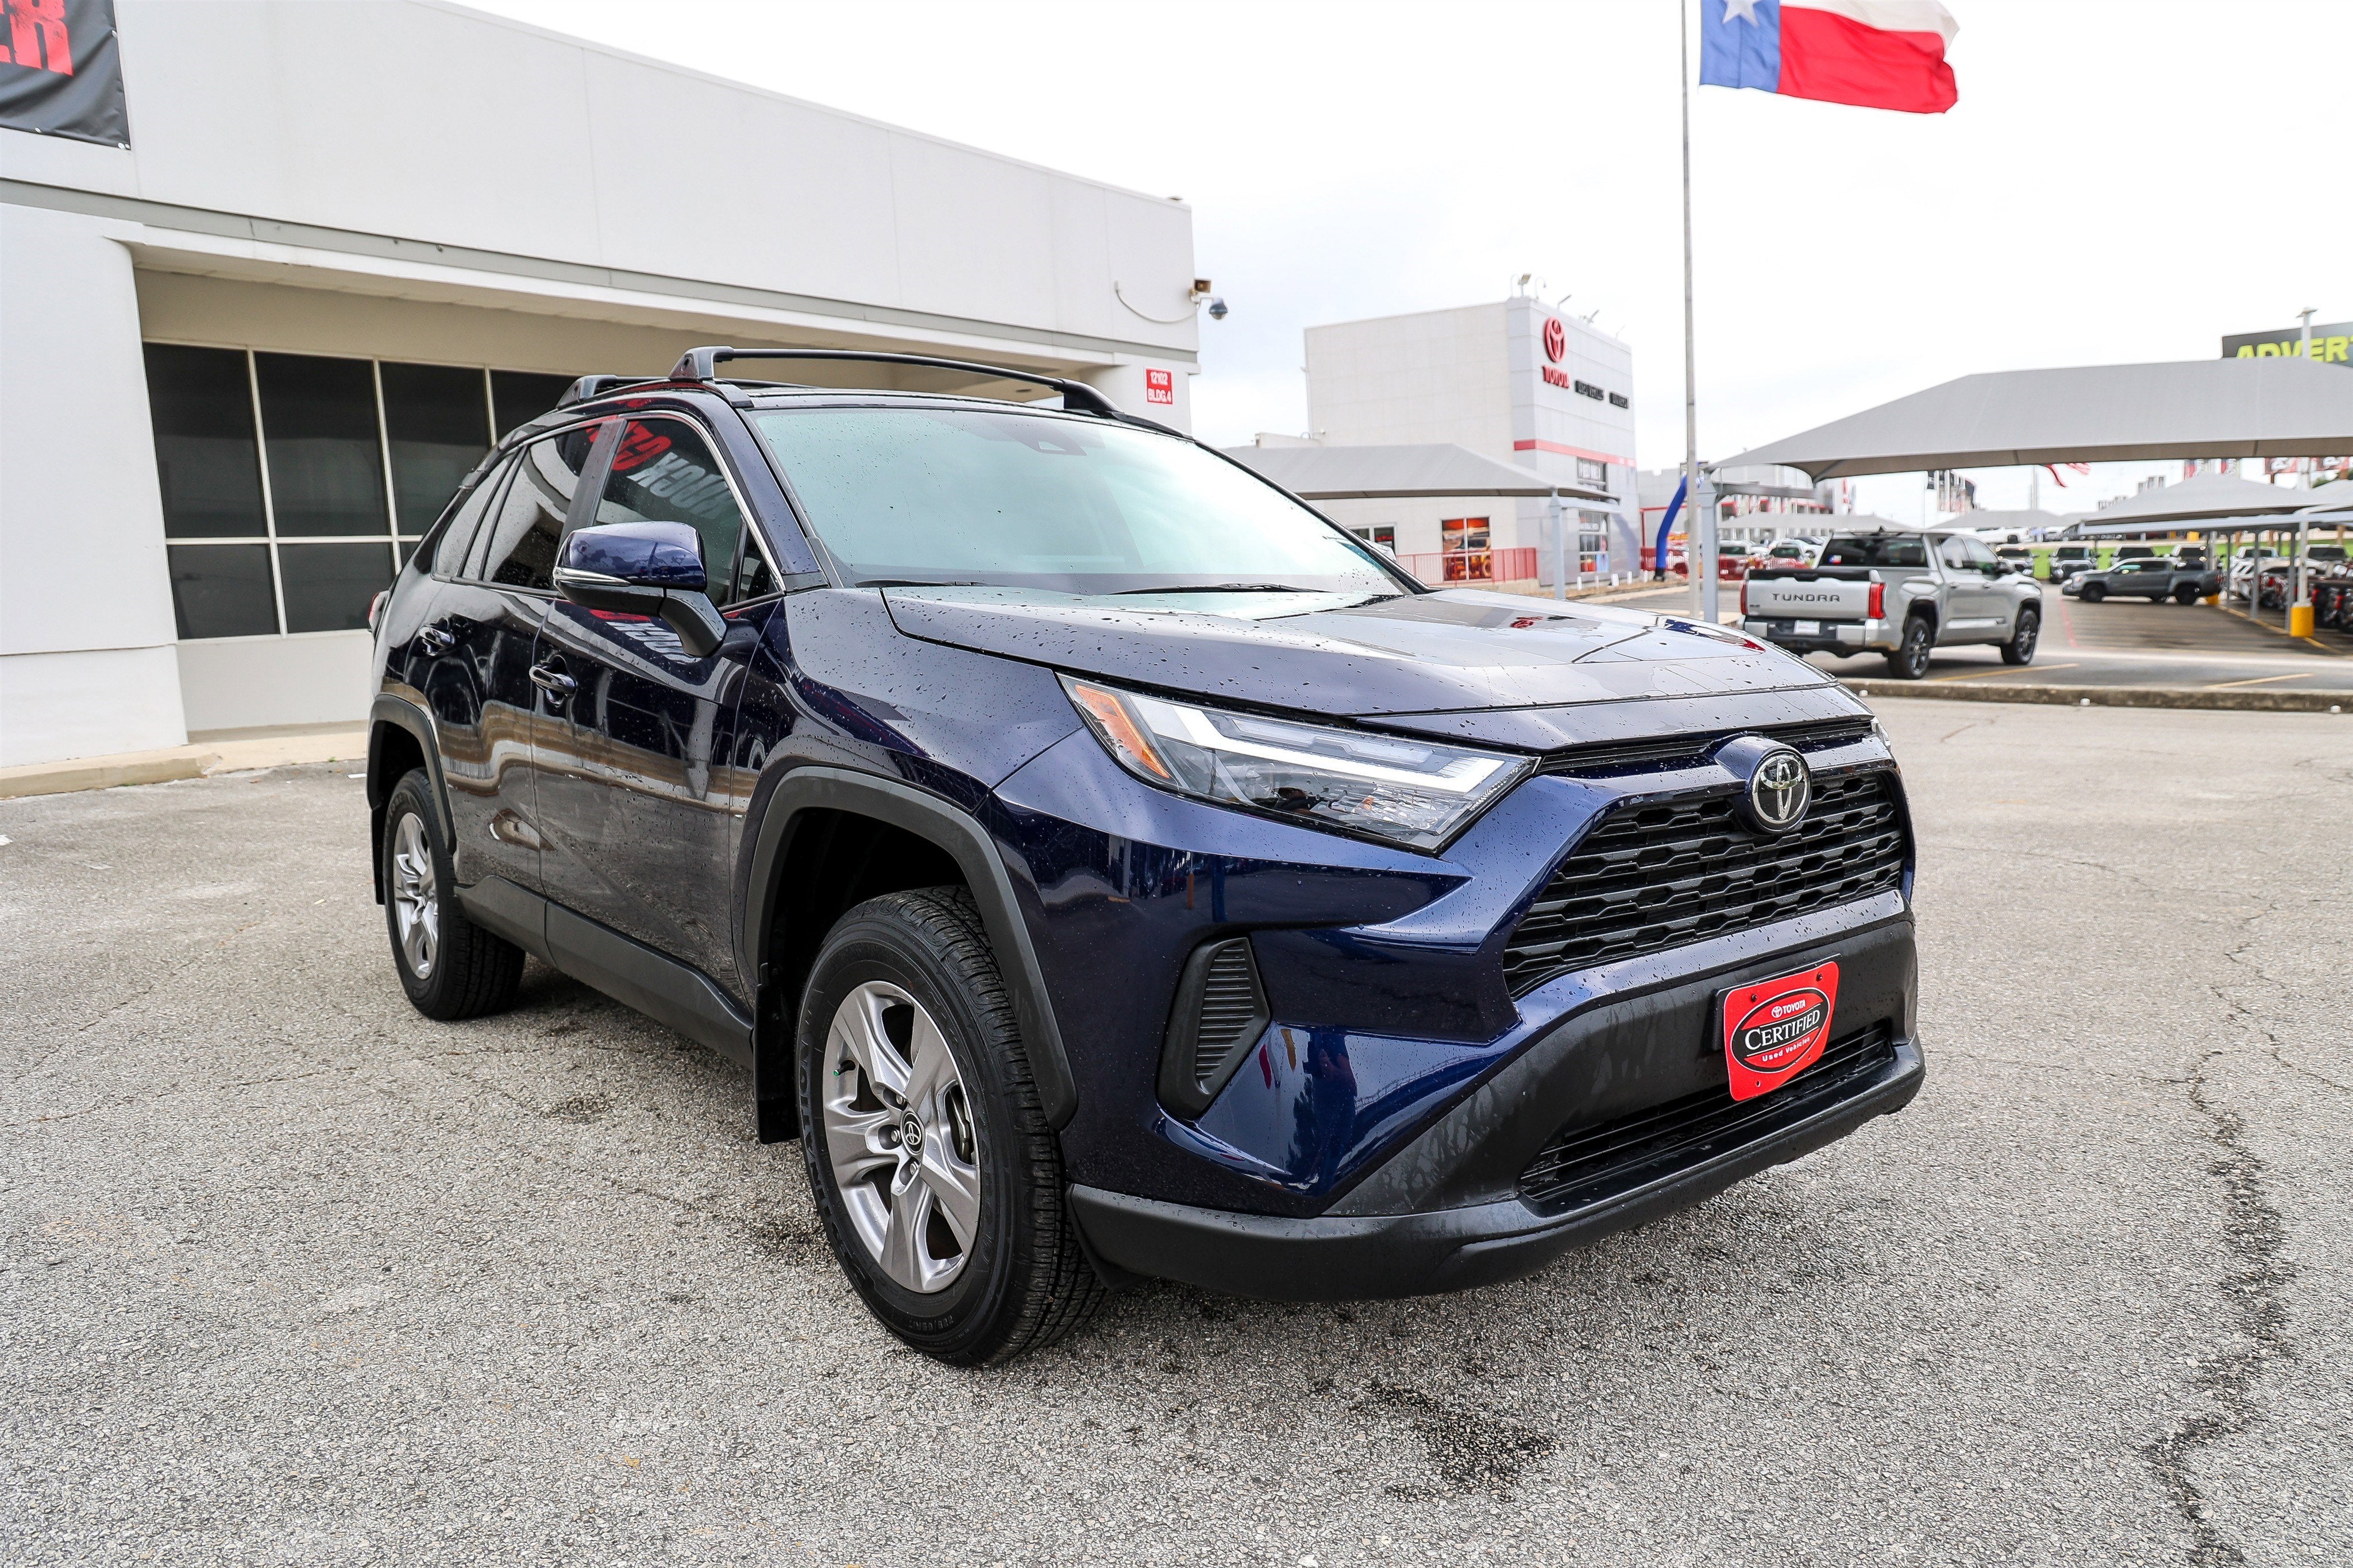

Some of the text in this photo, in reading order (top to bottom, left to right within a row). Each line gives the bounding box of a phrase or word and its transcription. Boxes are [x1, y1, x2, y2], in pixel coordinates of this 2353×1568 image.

[2236, 335, 2353, 362] ADVER
[1772, 593, 1841, 602] TUNDRA
[1783, 999, 1806, 1014] TOYOTA
[1745, 1009, 1820, 1051] CERTIFIED
[1761, 1037, 1810, 1061] Used Vehicles
